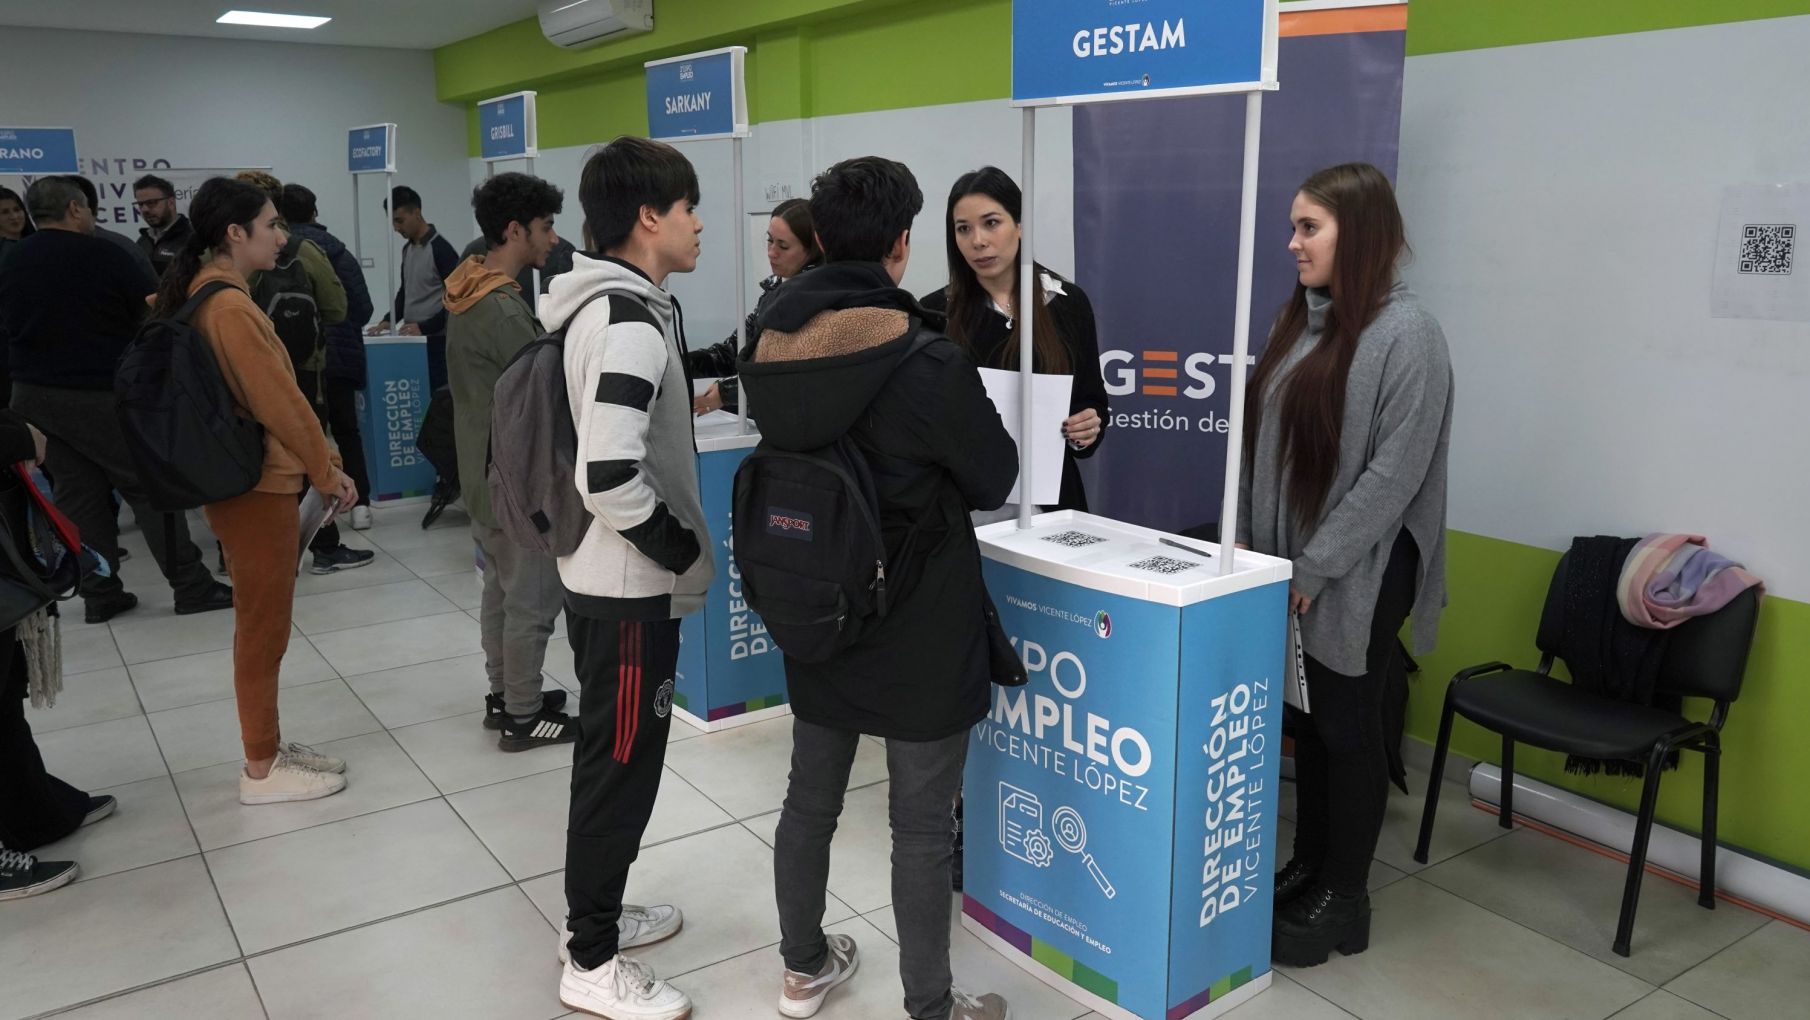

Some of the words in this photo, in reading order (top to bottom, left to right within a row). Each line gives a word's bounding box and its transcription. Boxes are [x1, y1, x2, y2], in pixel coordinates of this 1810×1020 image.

[1073, 18, 1186, 58] GESTAM
[665, 91, 711, 114] SARKANY
[382, 380, 402, 467] DIRECCIÓN
[398, 379, 414, 440] EMPLEO
[1199, 411, 1229, 433] de
[403, 446, 416, 466] DE
[769, 514, 810, 531] JANSPORT
[723, 512, 748, 661] DIRECC
[1006, 594, 1037, 611] VIVAMOS
[1038, 604, 1069, 620] VICENTE
[1069, 613, 1093, 627] LÓPEZ
[986, 682, 1151, 777] MPLEO
[1247, 677, 1269, 770] LÓPEZ
[976, 723, 1066, 775] VICENTE
[1074, 758, 1150, 811] LÓPEZ
[1223, 683, 1251, 849] EMPLEO
[1199, 692, 1229, 928] DIRECCIÓN
[1243, 778, 1263, 903] VICENTE
[1020, 892, 1054, 914] DIRECCIÓN
[1054, 909, 1063, 918] DE
[1064, 914, 1088, 932] EMPLEO
[1219, 858, 1241, 914] DE
[999, 889, 1033, 913] SECRETARÍA
[1033, 908, 1042, 918] DE
[1043, 912, 1080, 937] EDUCACIÓN
[1080, 932, 1085, 940] Y
[1085, 936, 1112, 954] EMPLEO
